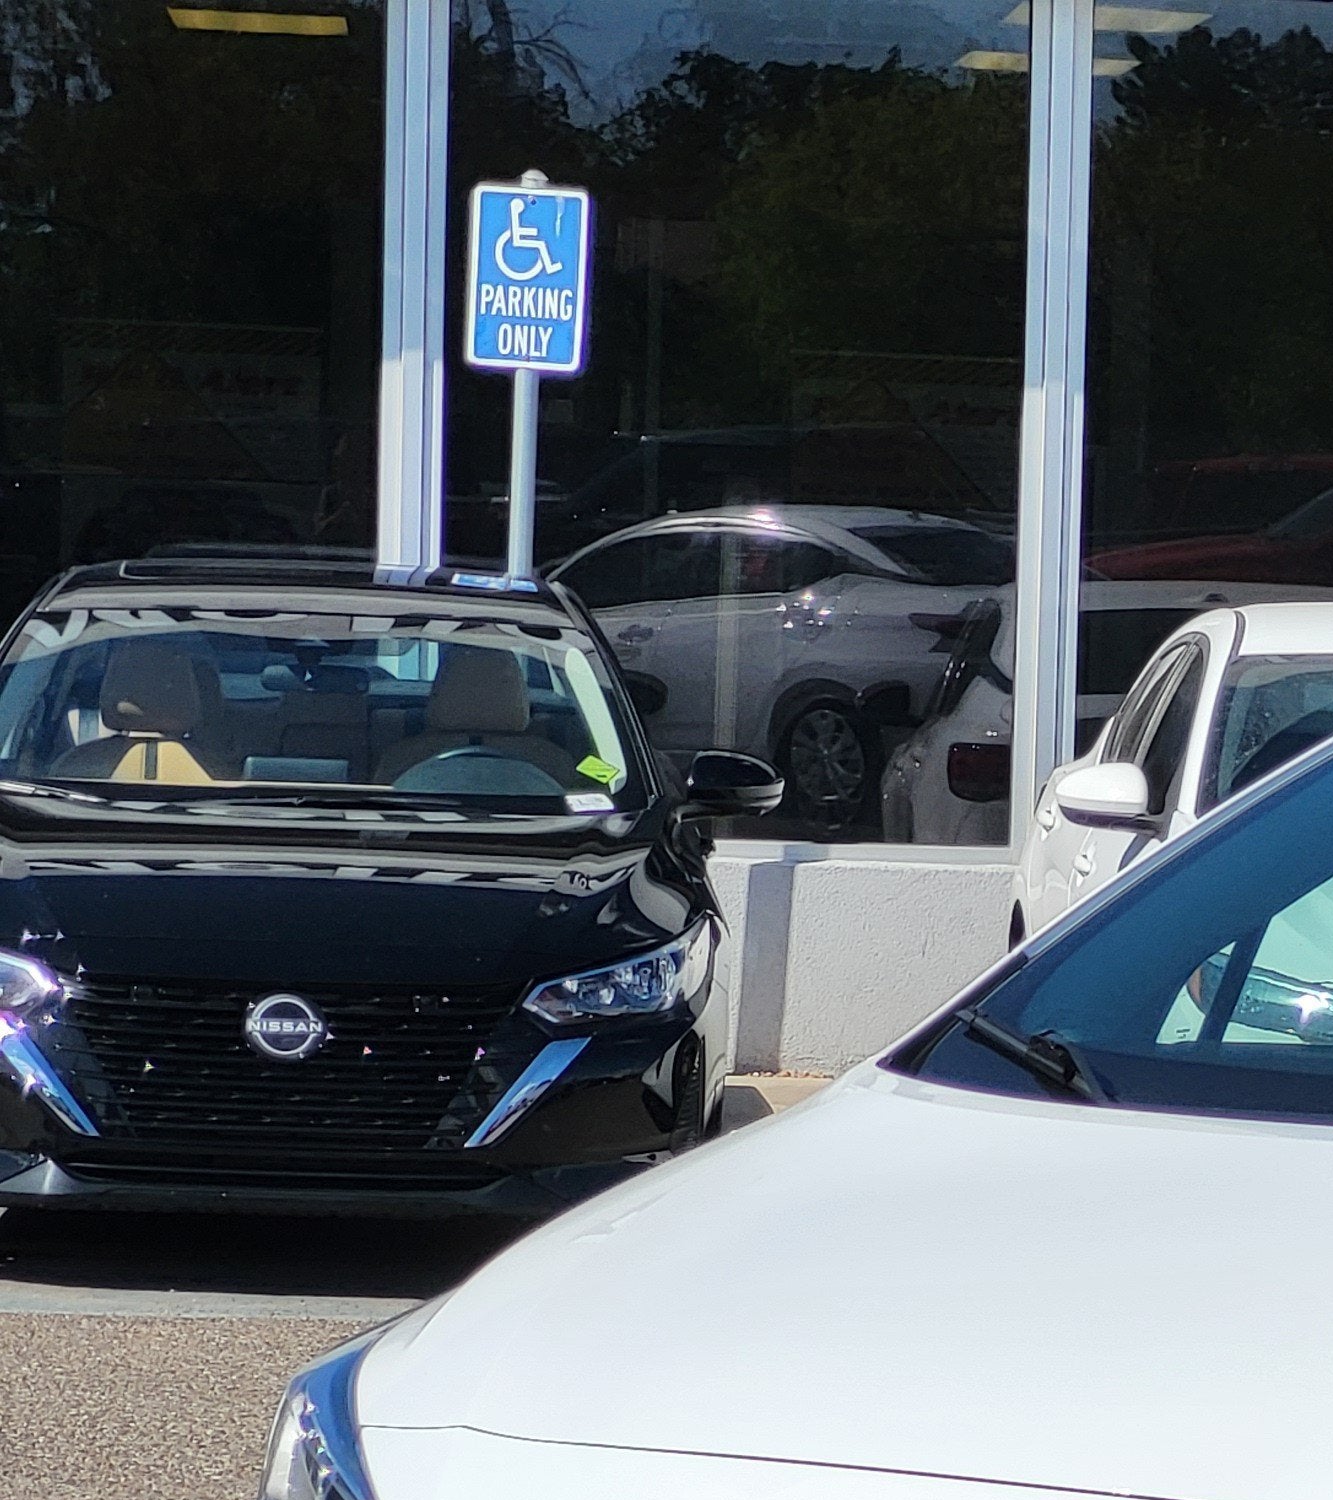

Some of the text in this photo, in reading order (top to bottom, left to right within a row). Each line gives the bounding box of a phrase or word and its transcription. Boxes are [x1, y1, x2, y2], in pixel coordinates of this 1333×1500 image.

[481, 284, 573, 321] PARKING
[498, 324, 554, 357] ONLY
[249, 1021, 322, 1033] NISSAN
